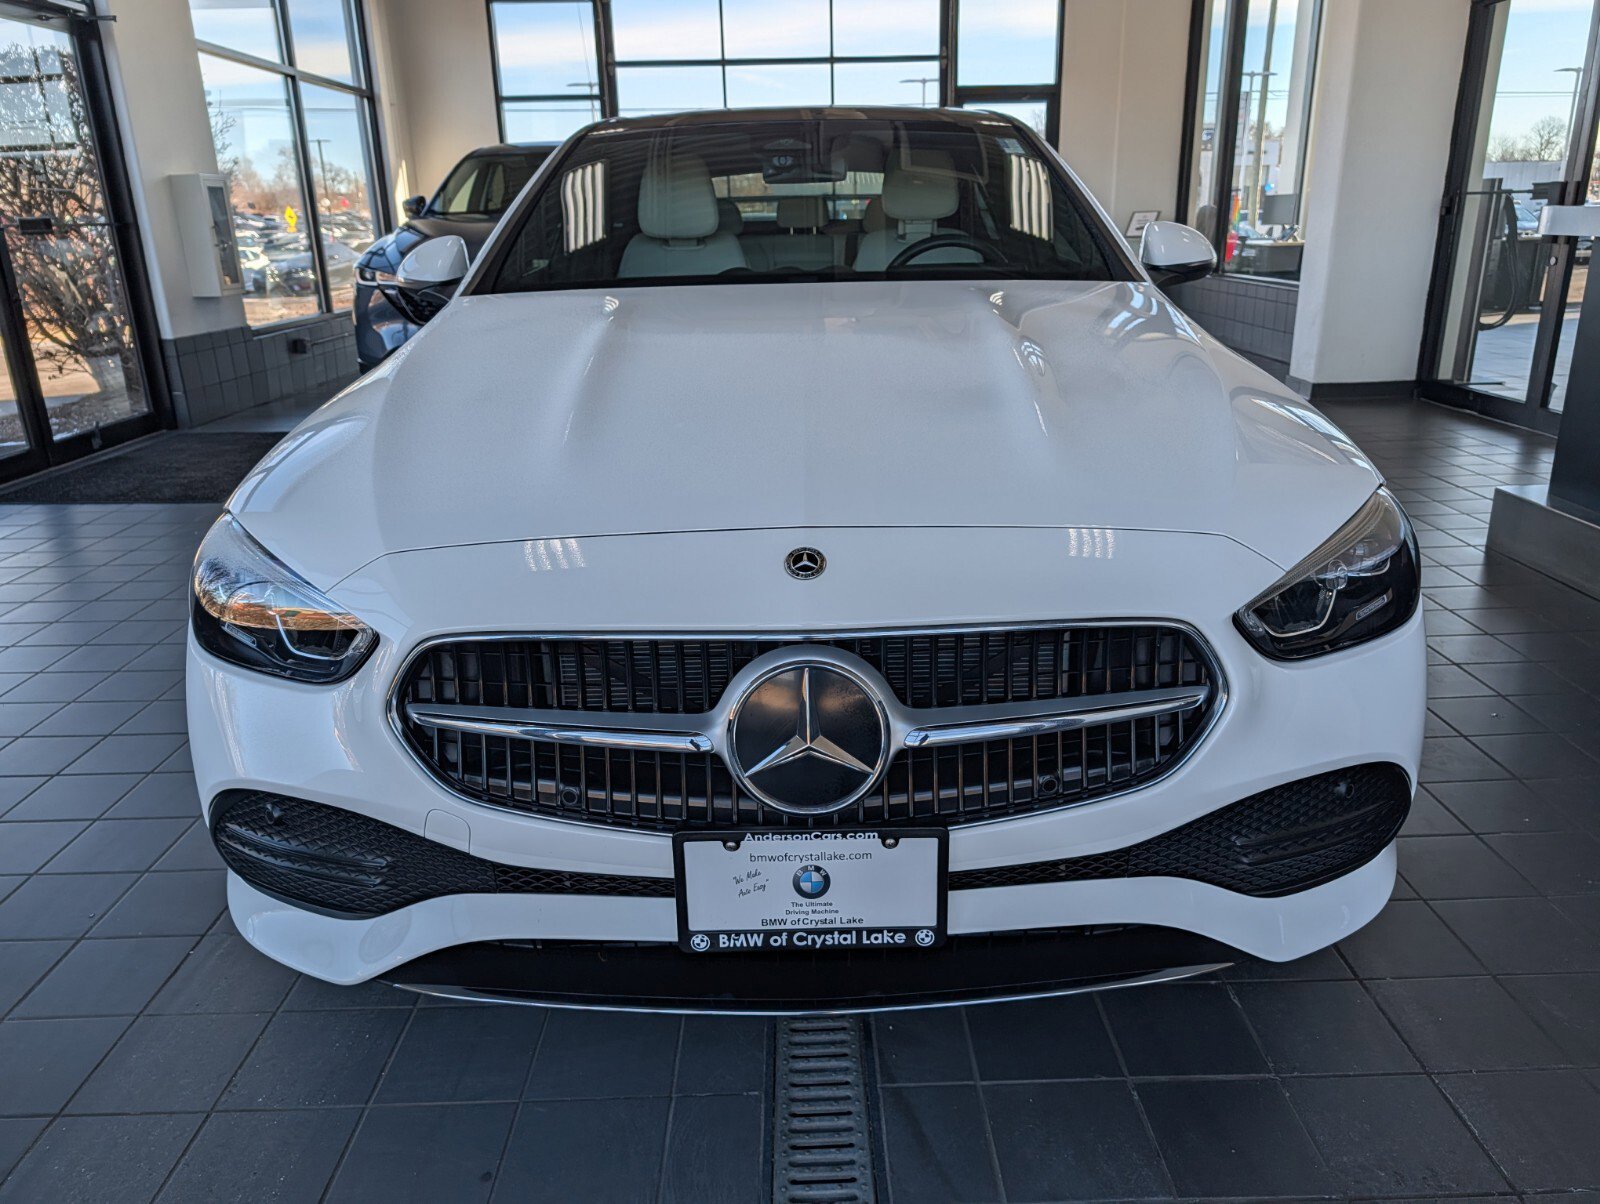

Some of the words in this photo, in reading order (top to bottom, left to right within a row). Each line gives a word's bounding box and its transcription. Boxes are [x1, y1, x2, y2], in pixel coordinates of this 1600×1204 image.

[744, 832, 879, 841] AndersonCars.com
[749, 852, 872, 863] bmwofcrystallake.com
[761, 918, 787, 926] BMW
[790, 918, 801, 926] of
[801, 917, 837, 927] Crystal
[839, 916, 864, 925] Lake
[719, 933, 764, 948] BMW
[769, 932, 788, 946] of
[792, 931, 857, 948] Crystal
[862, 930, 906, 944] Lake
